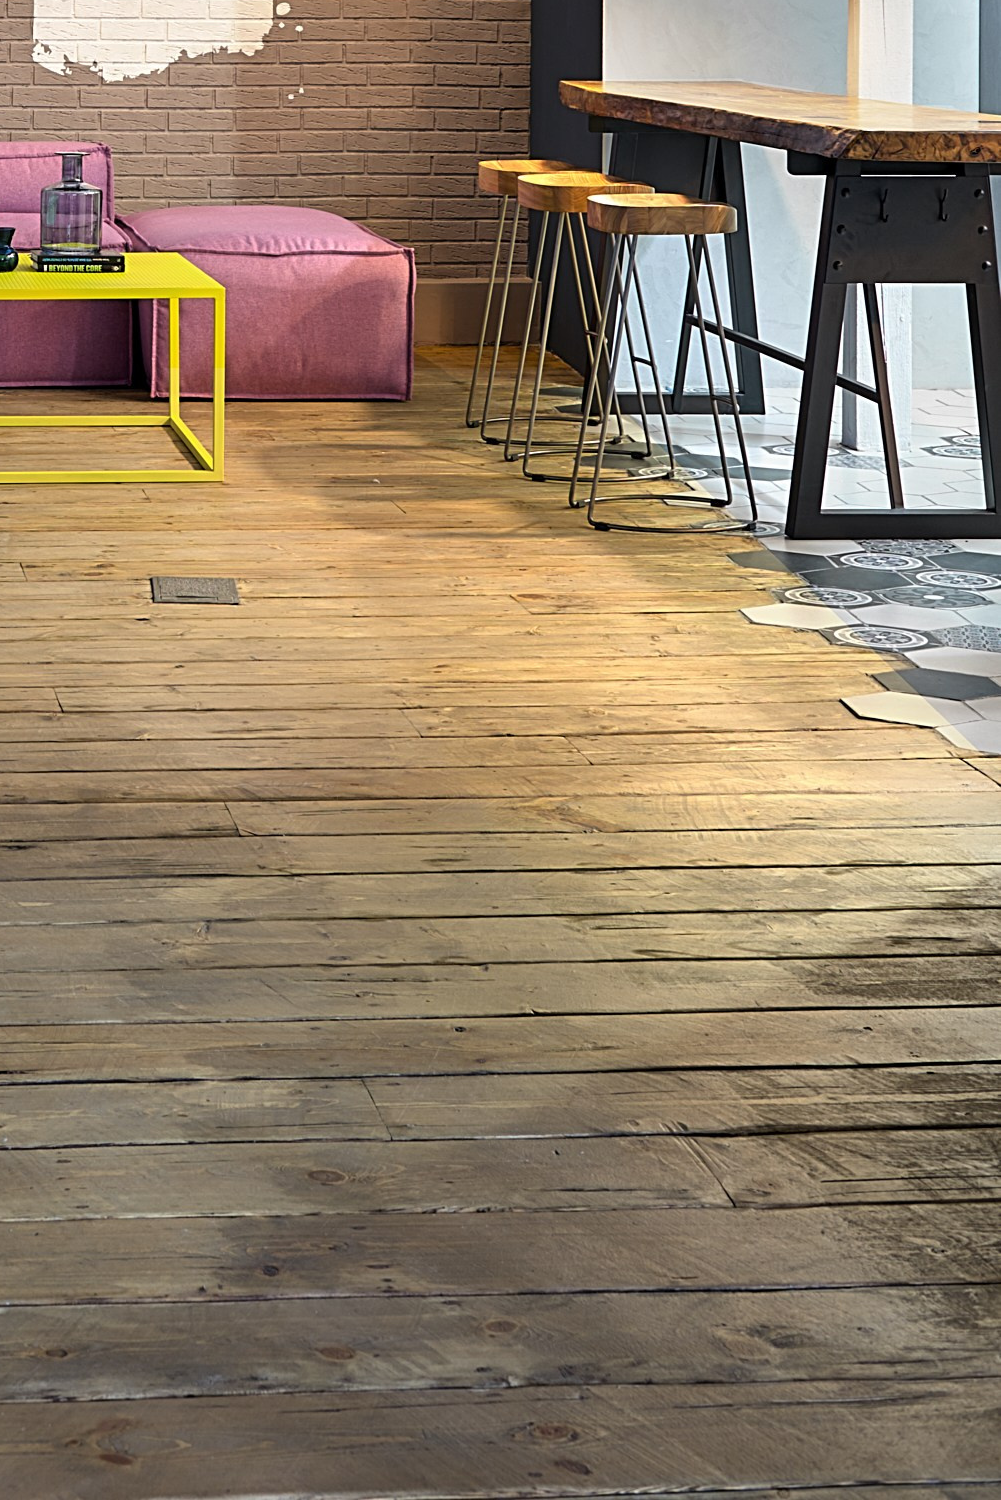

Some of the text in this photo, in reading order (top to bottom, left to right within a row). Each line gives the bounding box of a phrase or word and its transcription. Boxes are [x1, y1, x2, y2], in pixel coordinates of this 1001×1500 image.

[48, 264, 102, 272] BEYOND THE CORE
